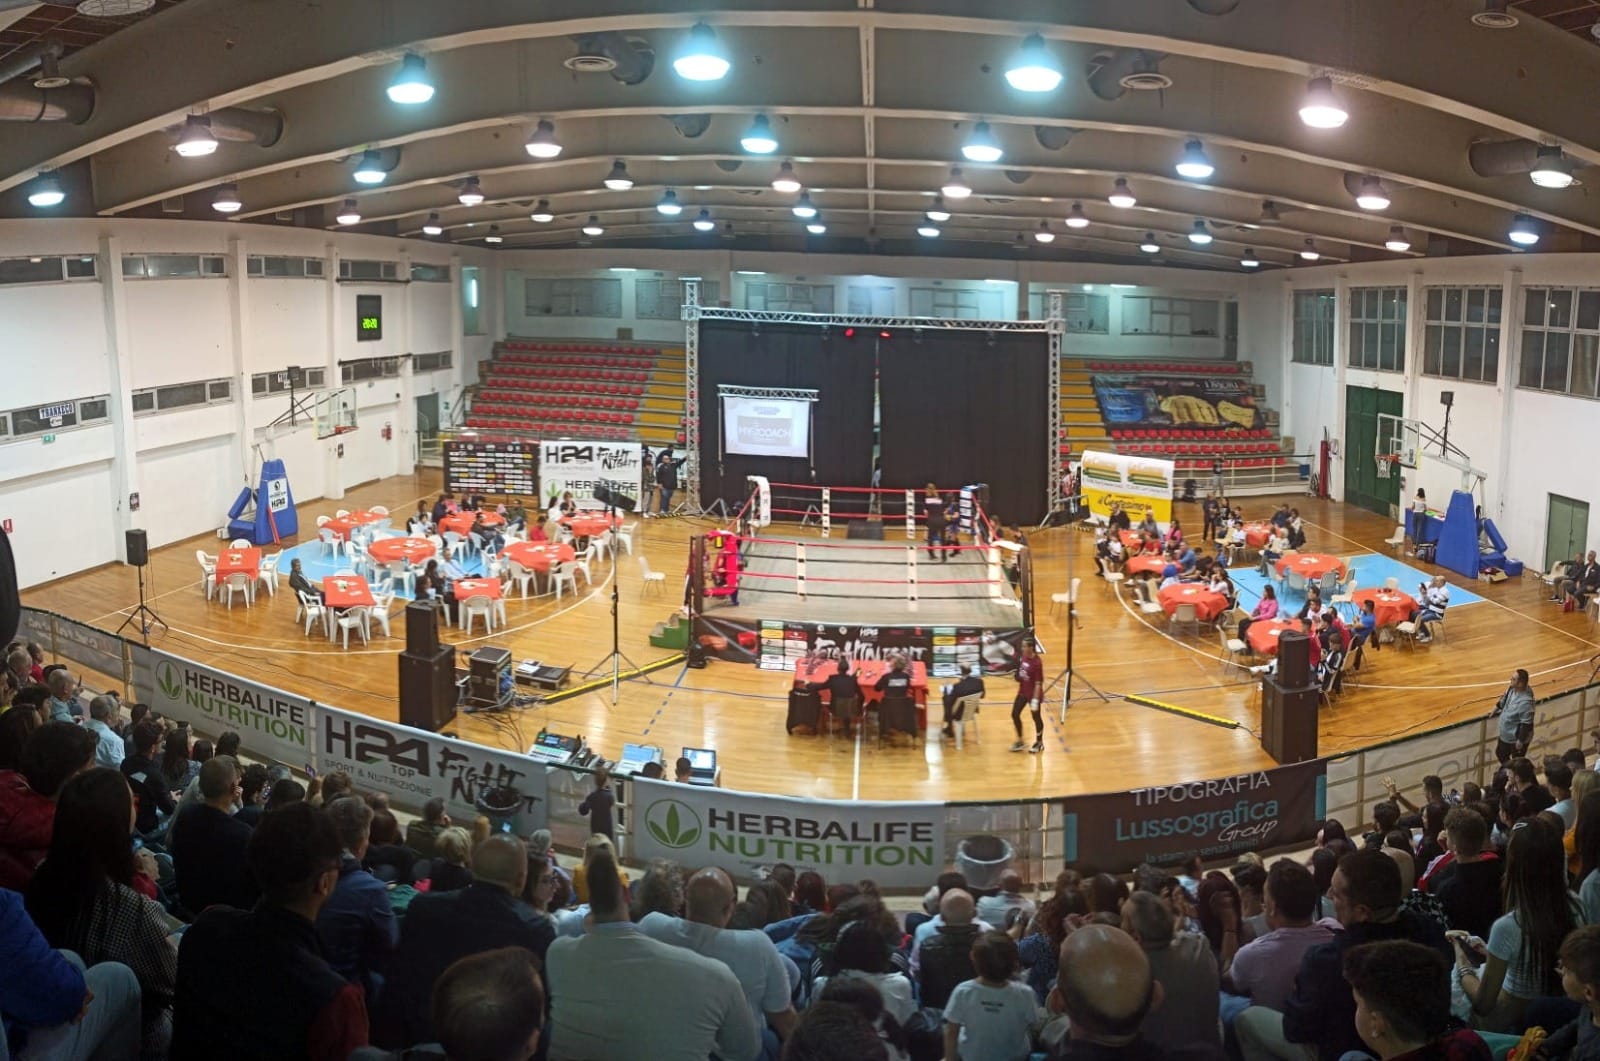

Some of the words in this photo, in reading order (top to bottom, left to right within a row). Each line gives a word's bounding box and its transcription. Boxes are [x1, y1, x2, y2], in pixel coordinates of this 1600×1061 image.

[546, 446, 593, 463] H24
[185, 669, 305, 725] HERBALIFE
[186, 689, 305, 746] NUTRITION
[325, 715, 431, 777] H24
[325, 759, 354, 773] SPORT
[368, 771, 432, 797] NUTRIZIONE
[392, 764, 415, 778] TOP
[1130, 771, 1271, 806] TIPOGRAFIA
[709, 808, 933, 842] HERBALIFE
[1116, 800, 1278, 841] Lussografica
[1218, 820, 1278, 842] Group
[709, 831, 933, 866] NUTRITION
